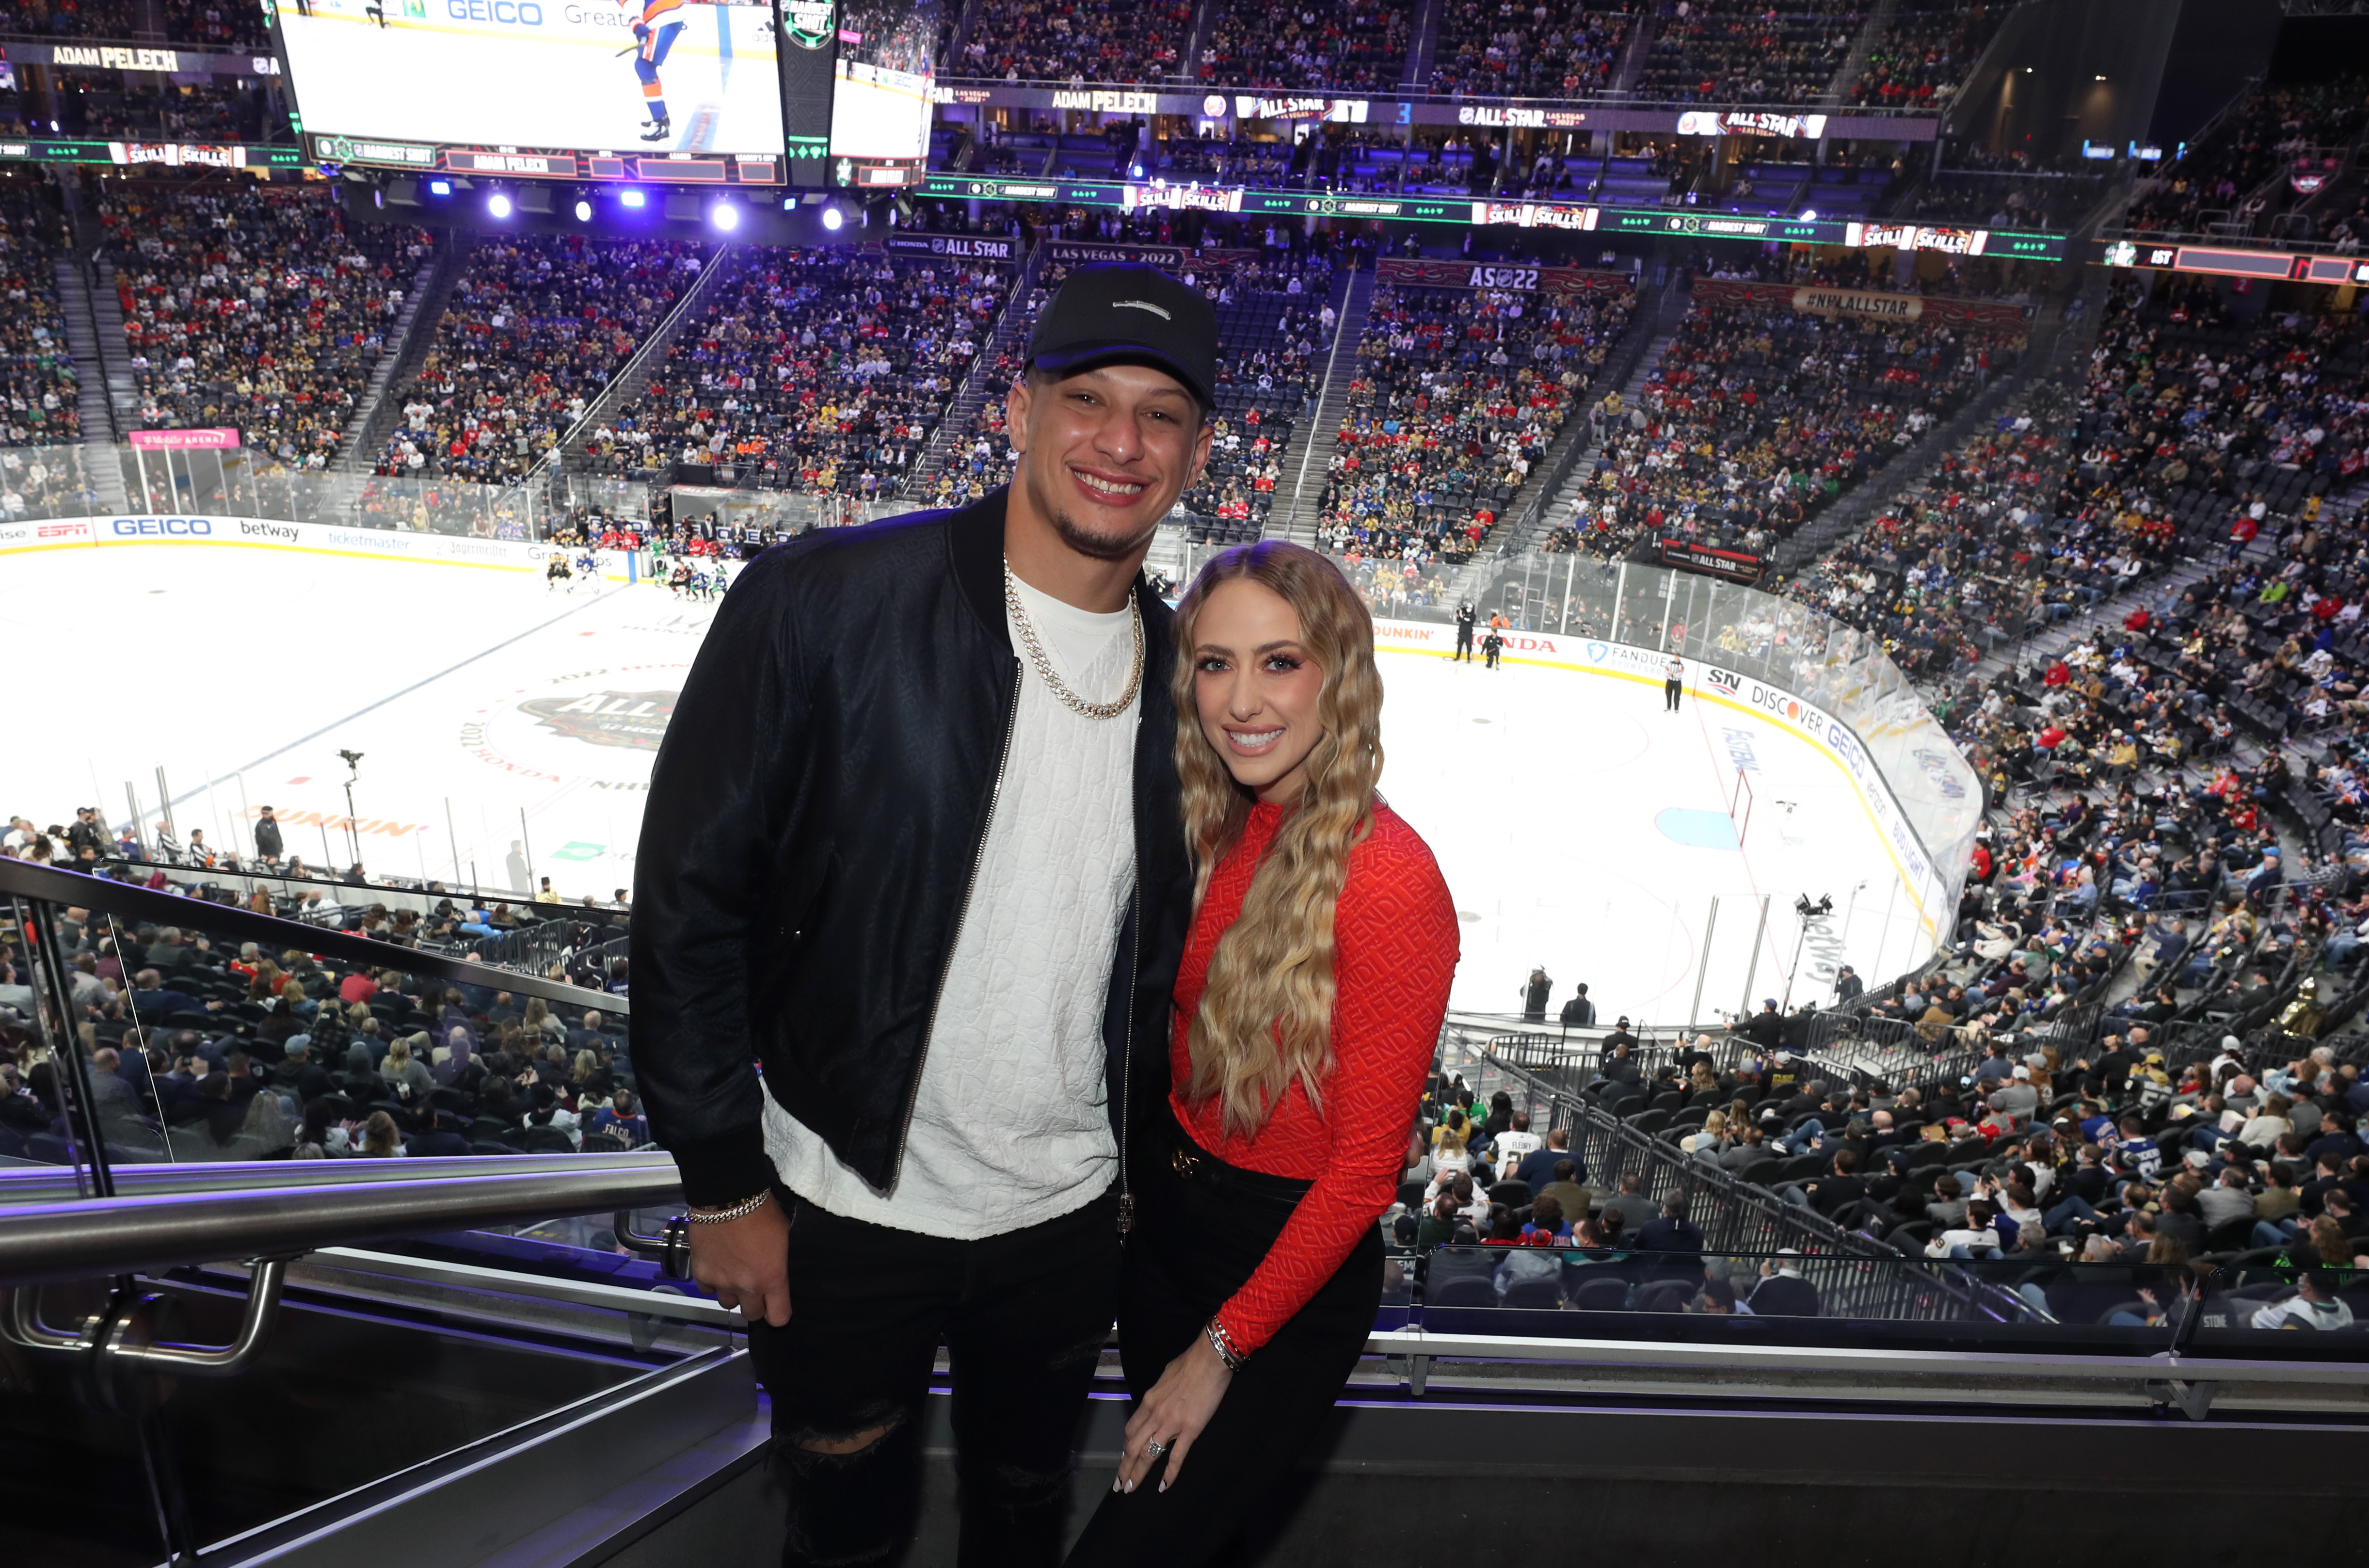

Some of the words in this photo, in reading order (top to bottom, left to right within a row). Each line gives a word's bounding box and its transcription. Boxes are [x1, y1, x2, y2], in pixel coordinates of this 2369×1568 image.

[448, 0, 543, 26] GEICO
[565, 4, 628, 27] Great
[789, 1, 833, 16] HARDEST
[793, 14, 828, 31] SHOT
[53, 47, 100, 66] ADAM
[100, 47, 178, 72] PELECH
[1052, 91, 1091, 109] ADAM
[1092, 91, 1157, 114] PELECH
[1260, 99, 1287, 119] ALL
[1473, 107, 1504, 126] ALL
[1505, 108, 1545, 127] STAR
[1727, 113, 1756, 126] ALL
[1759, 114, 1798, 138] STAR
[4, 144, 27, 156] SHOT
[181, 148, 227, 164] SKILLS
[364, 144, 405, 161] HARDEST
[406, 149, 432, 163] SHOT
[475, 155, 506, 171] ADAM
[507, 157, 550, 173] PELECH
[1005, 186, 1036, 195] HARDEST
[1037, 188, 1056, 197] SHOT
[1185, 193, 1226, 208] SKILLS
[1345, 203, 1379, 213] HARDEST
[1378, 204, 1400, 214] SHOT
[1537, 209, 1581, 226] SKILLS
[1708, 222, 1743, 232] HARDEST
[1743, 224, 1766, 234] SHOT
[896, 240, 929, 248] HONDA
[945, 239, 972, 255] ALL
[974, 240, 1008, 258] STAR
[1917, 232, 1966, 249] SKILLS
[1052, 248, 1079, 260] LAS
[1081, 249, 1126, 261] VEGAS
[1139, 252, 1175, 265] 2022
[1469, 267, 1496, 288] AS
[1513, 269, 1538, 290] 22
[185, 436, 220, 444] ARENA
[39, 524, 89, 538] ESPN
[114, 519, 211, 535] GEICO
[240, 520, 300, 542] betway
[329, 531, 412, 550] ticketmaster
[1699, 558, 1715, 568] ALL
[1715, 559, 1737, 572] STAR
[1372, 625, 1434, 640] DUNKIN'
[544, 669, 612, 685] 2022
[1707, 669, 1741, 691] SN
[555, 694, 658, 718] ALL
[1752, 685, 1823, 735] DISCOVER
[460, 722, 486, 747] 2022
[1827, 723, 1865, 780] GEICO
[470, 748, 561, 783] HONDA
[1866, 777, 1887, 821] verizon
[1893, 820, 1906, 845] BUD
[1904, 842, 1925, 882] LIGHT
[1366, 960, 1442, 1023] FENDI
[1342, 1024, 1421, 1077] FENDI
[1512, 1141, 1532, 1151] FLEURY
[1286, 1223, 1361, 1248] FENDI
[2203, 1315, 2227, 1328] STONE
